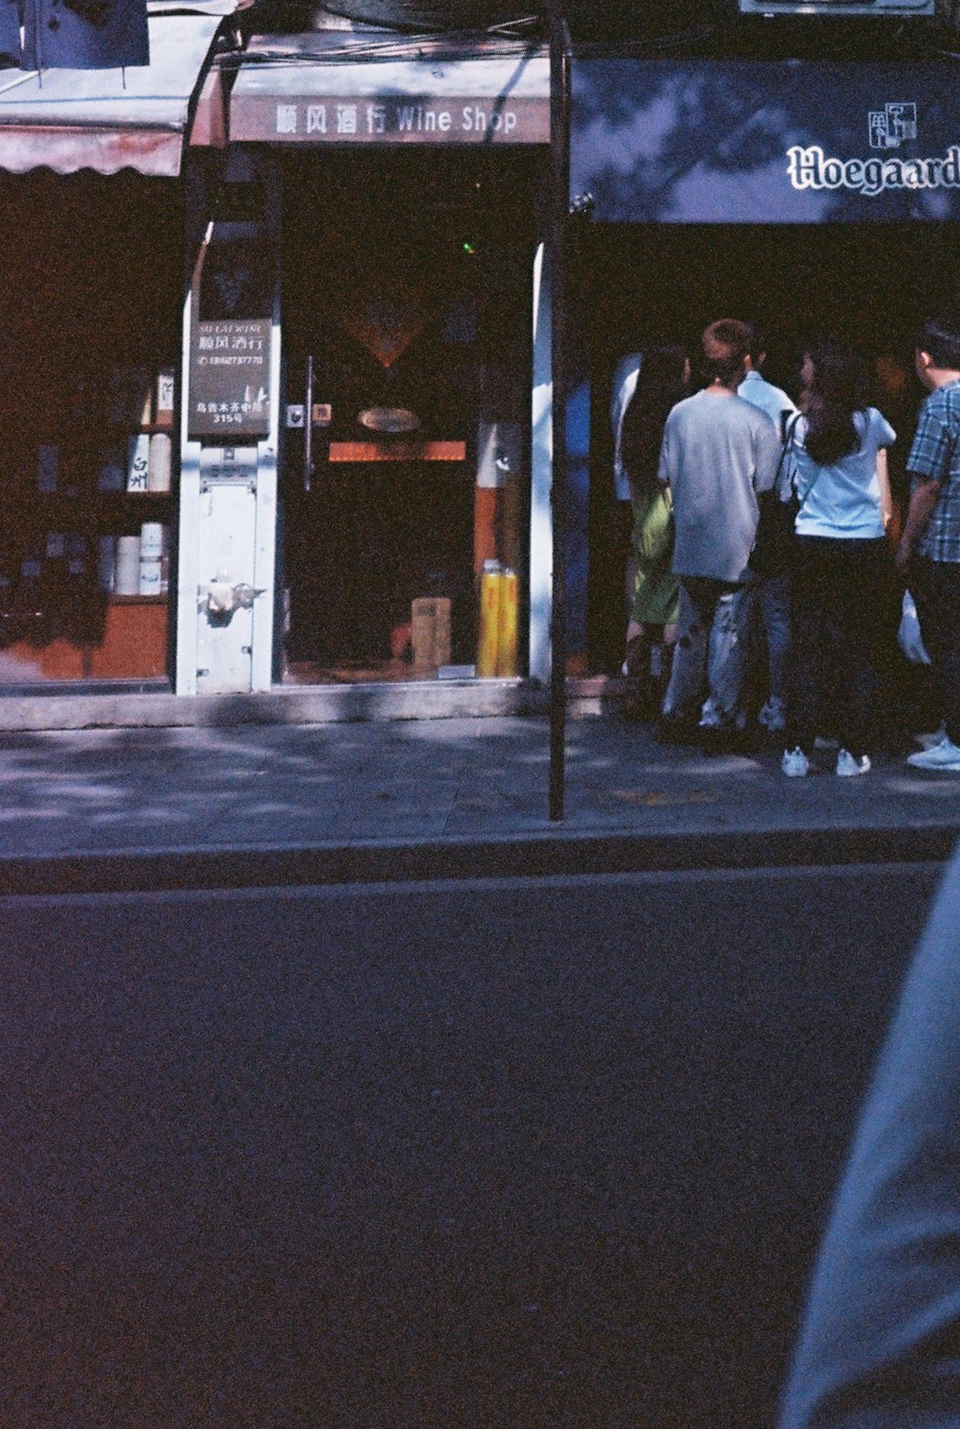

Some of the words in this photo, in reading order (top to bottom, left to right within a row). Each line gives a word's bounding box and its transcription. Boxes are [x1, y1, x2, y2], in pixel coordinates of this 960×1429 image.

[276, 104, 386, 134] 顺风酒行
[396, 105, 452, 132] Wine
[462, 106, 517, 134] Shop
[213, 413, 242, 424] 315号
